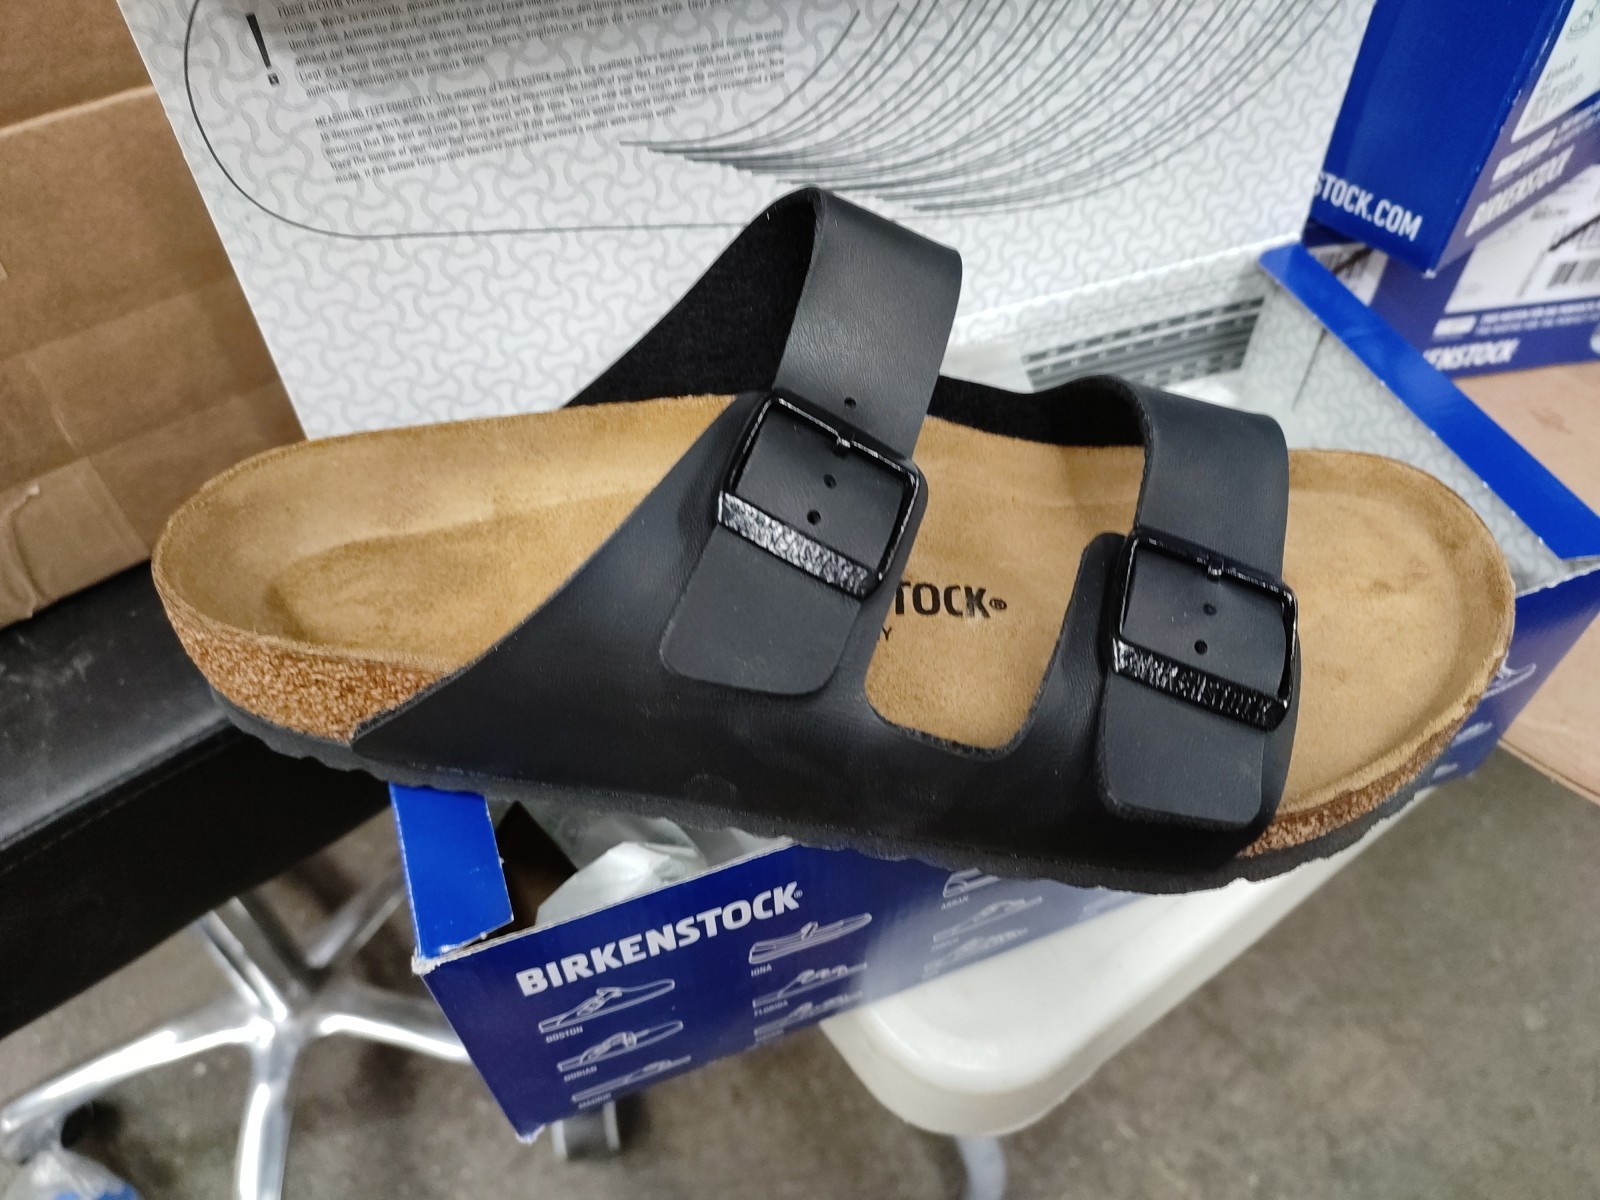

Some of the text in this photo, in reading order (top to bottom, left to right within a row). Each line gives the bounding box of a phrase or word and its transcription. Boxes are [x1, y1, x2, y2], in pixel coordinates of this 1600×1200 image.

[283, 20, 317, 36] richtige
[319, 13, 345, 28] Weite
[348, 13, 359, 22] zu
[314, 109, 364, 127] MEASURING
[364, 104, 386, 117] FEET
[437, 92, 452, 103] The
[498, 72, 551, 91] BIRKENSTOCK
[375, 118, 400, 131] which
[751, 963, 772, 977] IONA
[546, 1025, 583, 1043] BOSTON
